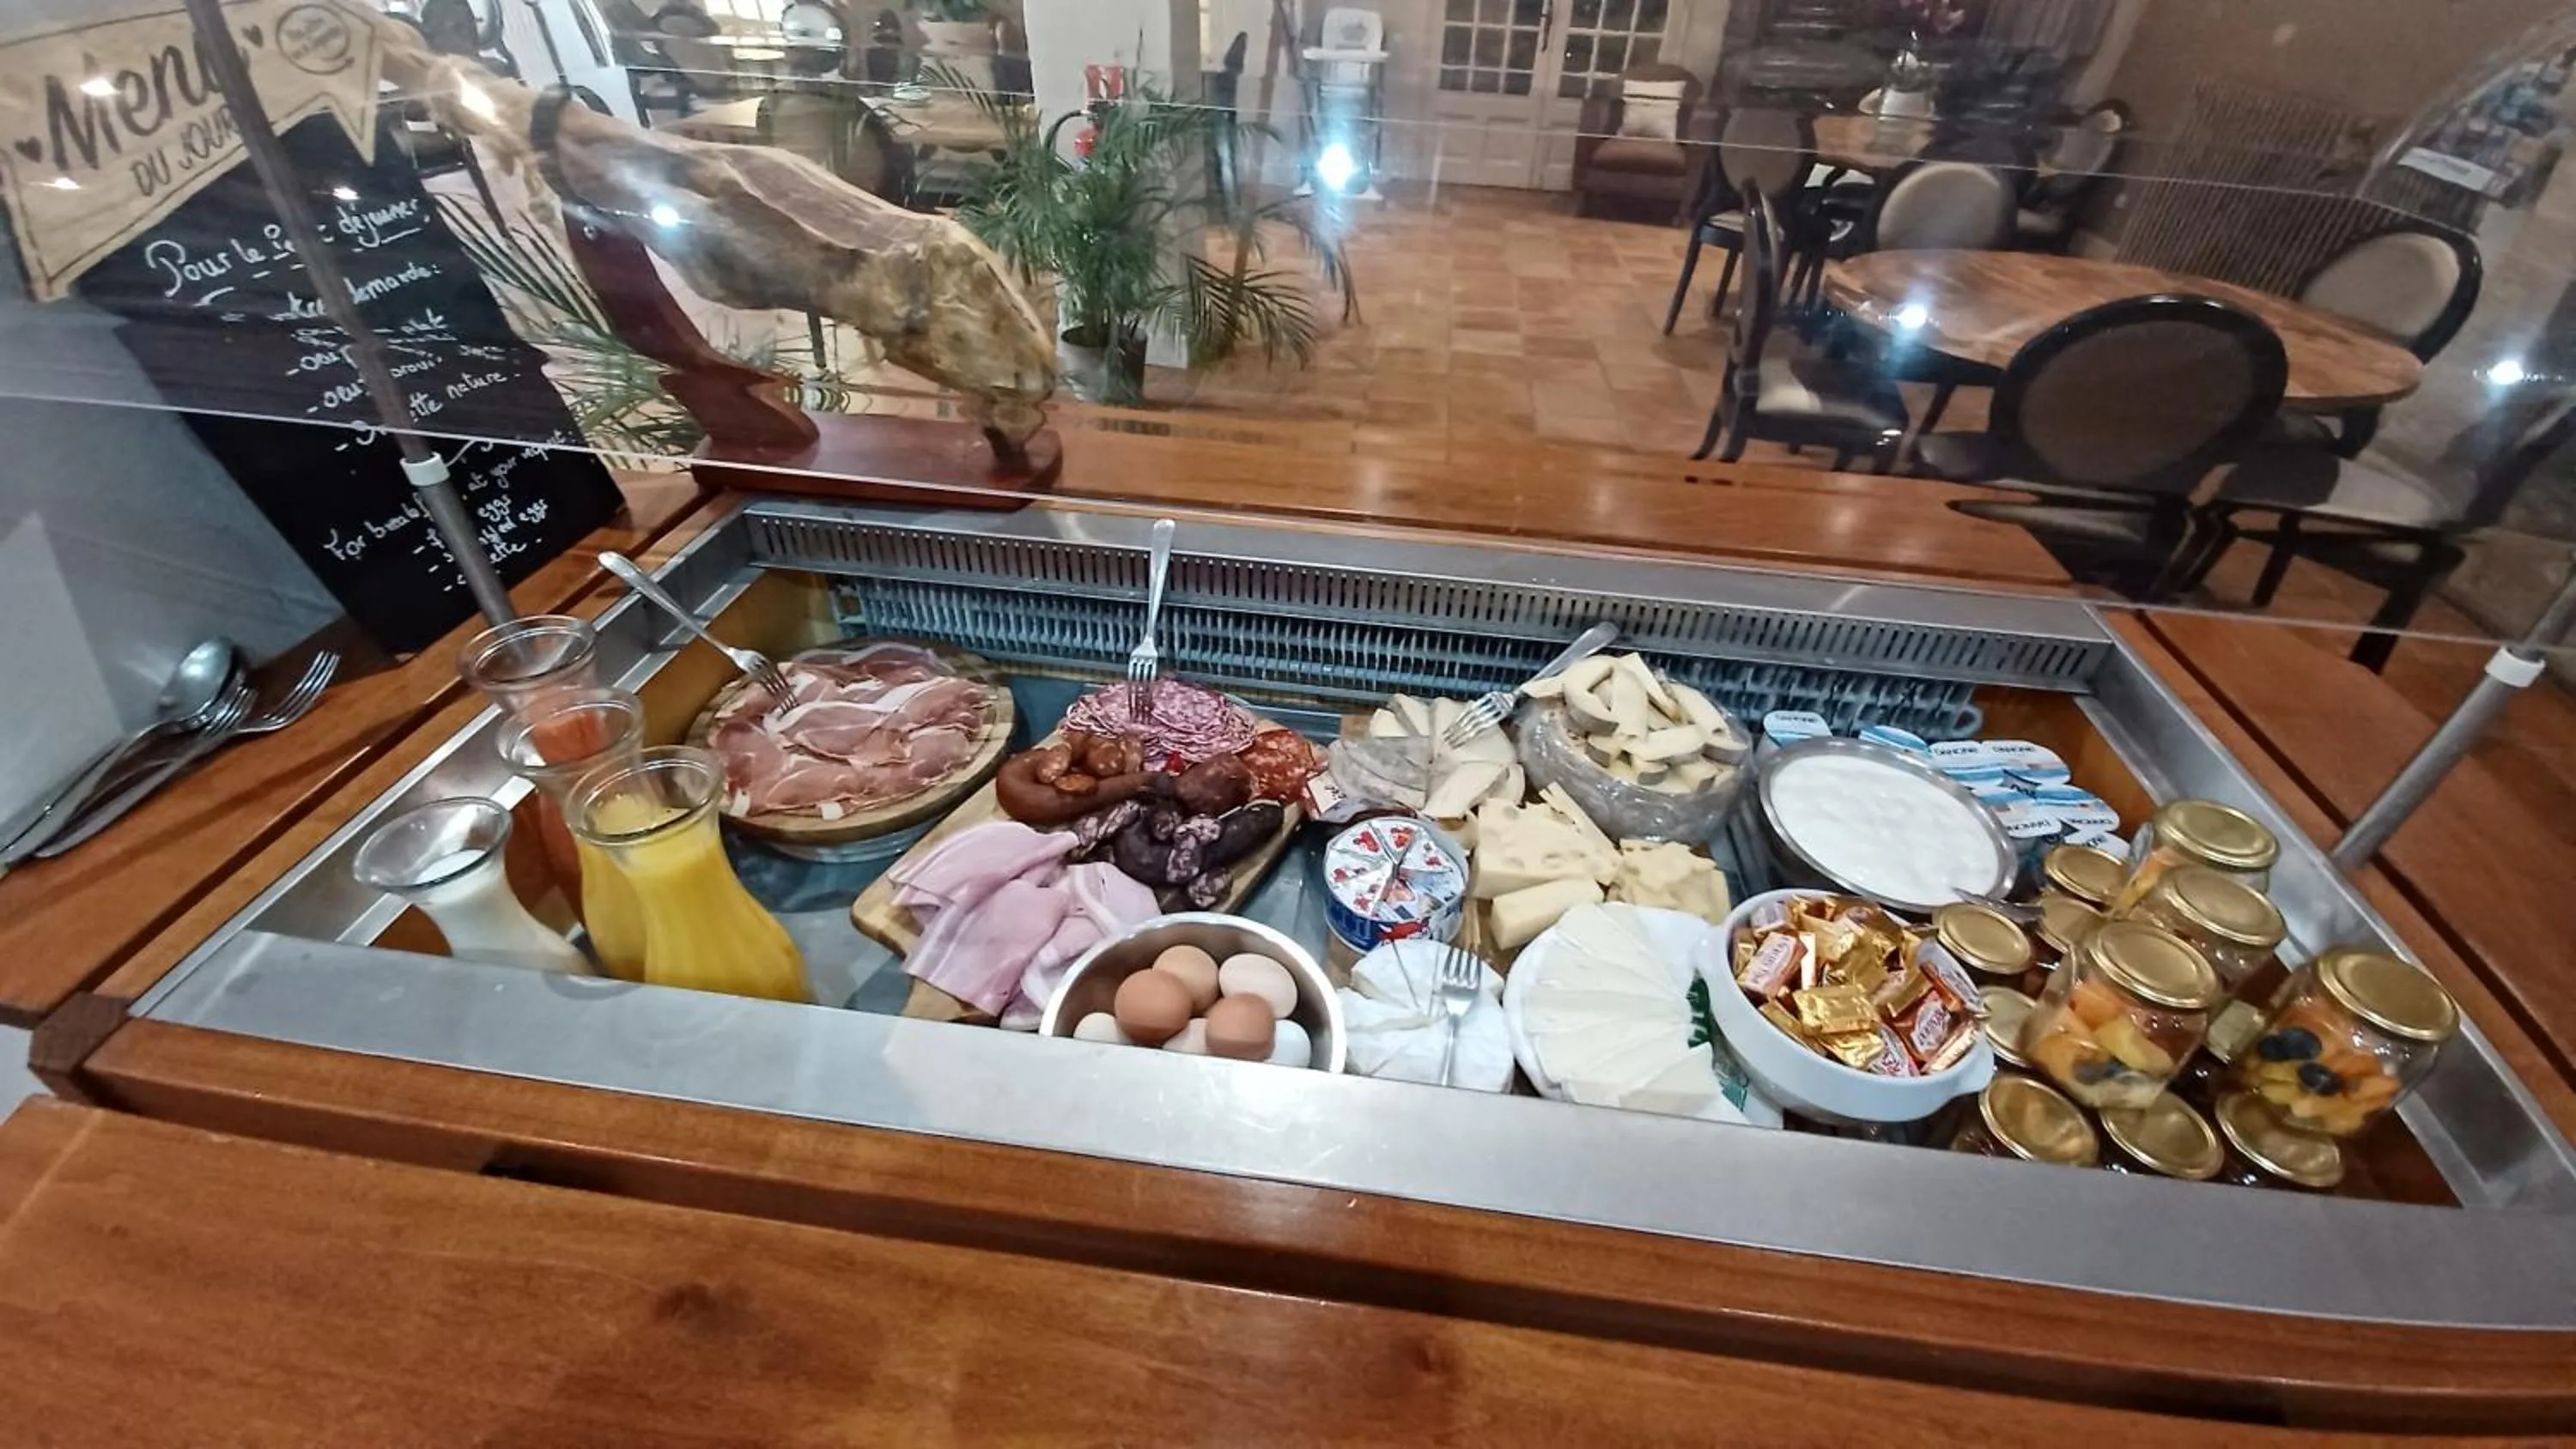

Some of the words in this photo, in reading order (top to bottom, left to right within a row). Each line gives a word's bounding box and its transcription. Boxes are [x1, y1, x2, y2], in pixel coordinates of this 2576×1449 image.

[130, 145, 172, 197] DU
[144, 239, 233, 298] Pour
[229, 237, 266, 264] le
[477, 494, 513, 523] eggs
[518, 498, 549, 524] eggs
[323, 528, 367, 561] For
